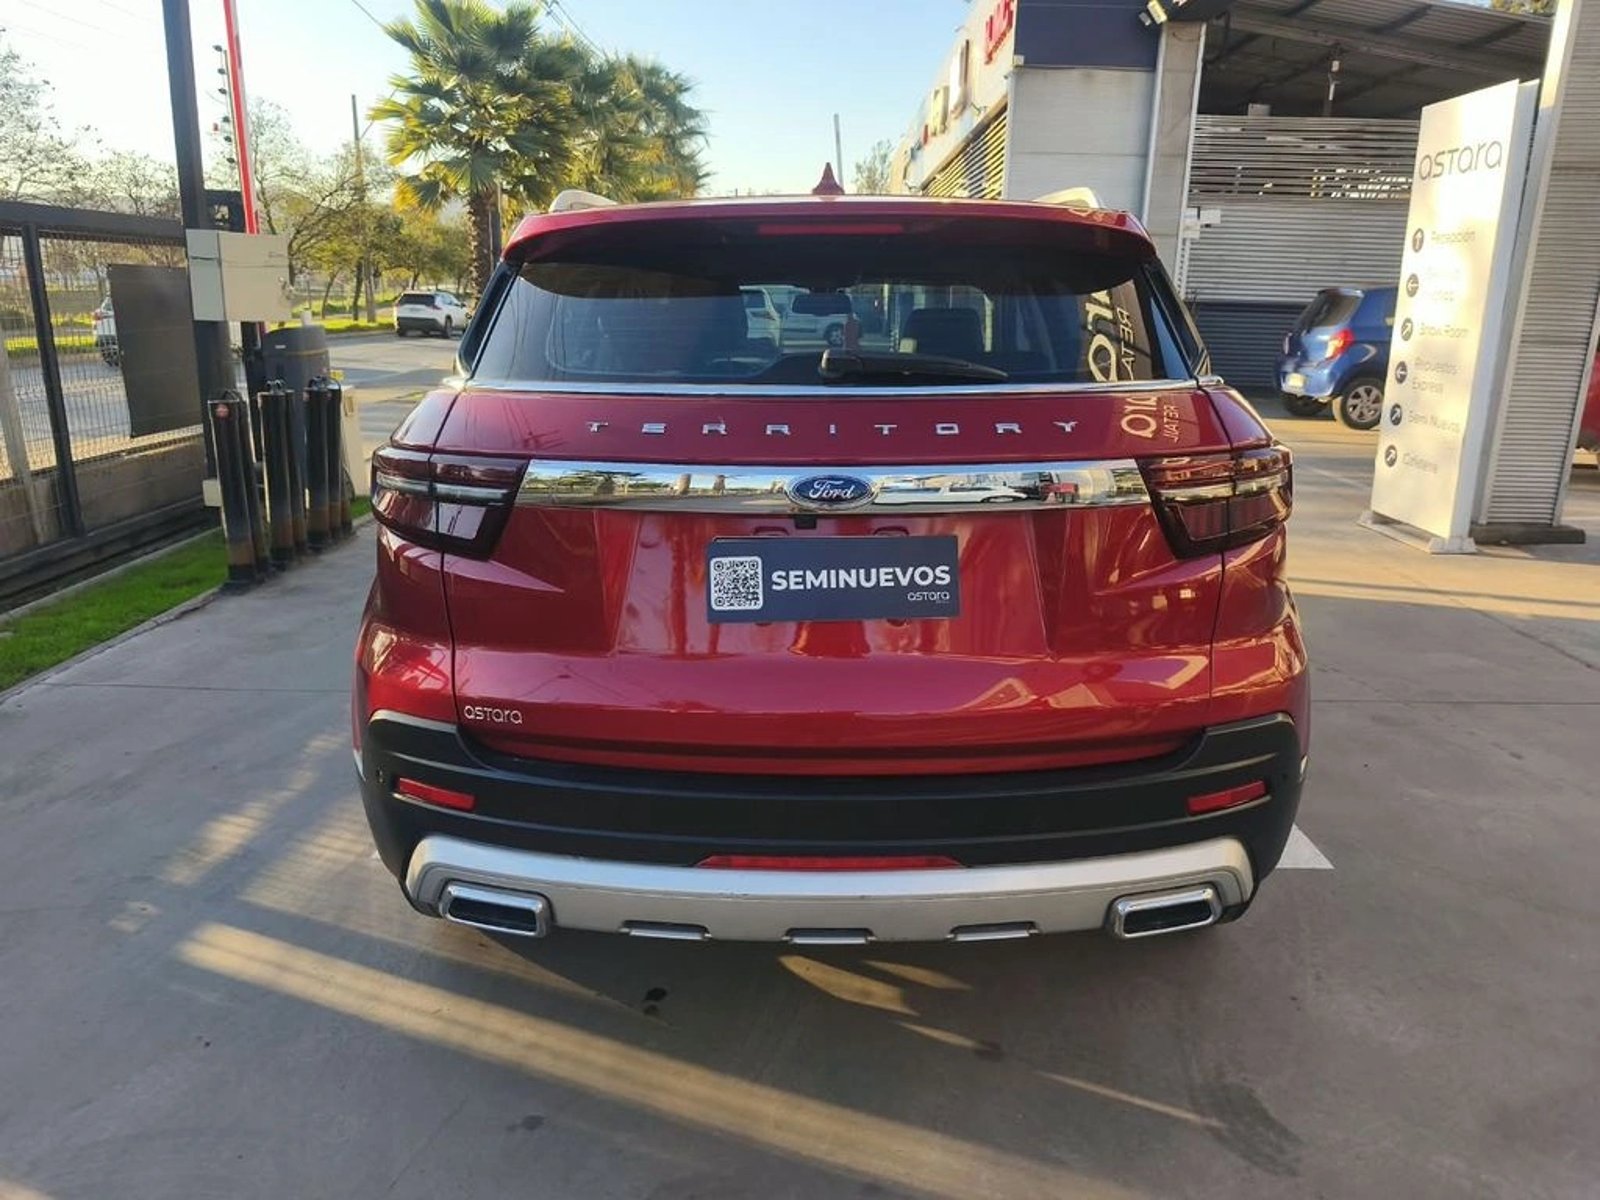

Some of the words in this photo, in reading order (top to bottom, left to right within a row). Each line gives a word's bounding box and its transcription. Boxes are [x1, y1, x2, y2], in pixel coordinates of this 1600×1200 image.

[1418, 140, 1502, 180] astara
[586, 419, 1079, 436] TERRITORY
[809, 478, 855, 499] Ford
[771, 565, 951, 591] SEMINUEVOS
[907, 591, 950, 601] astara
[463, 705, 523, 725] astara
